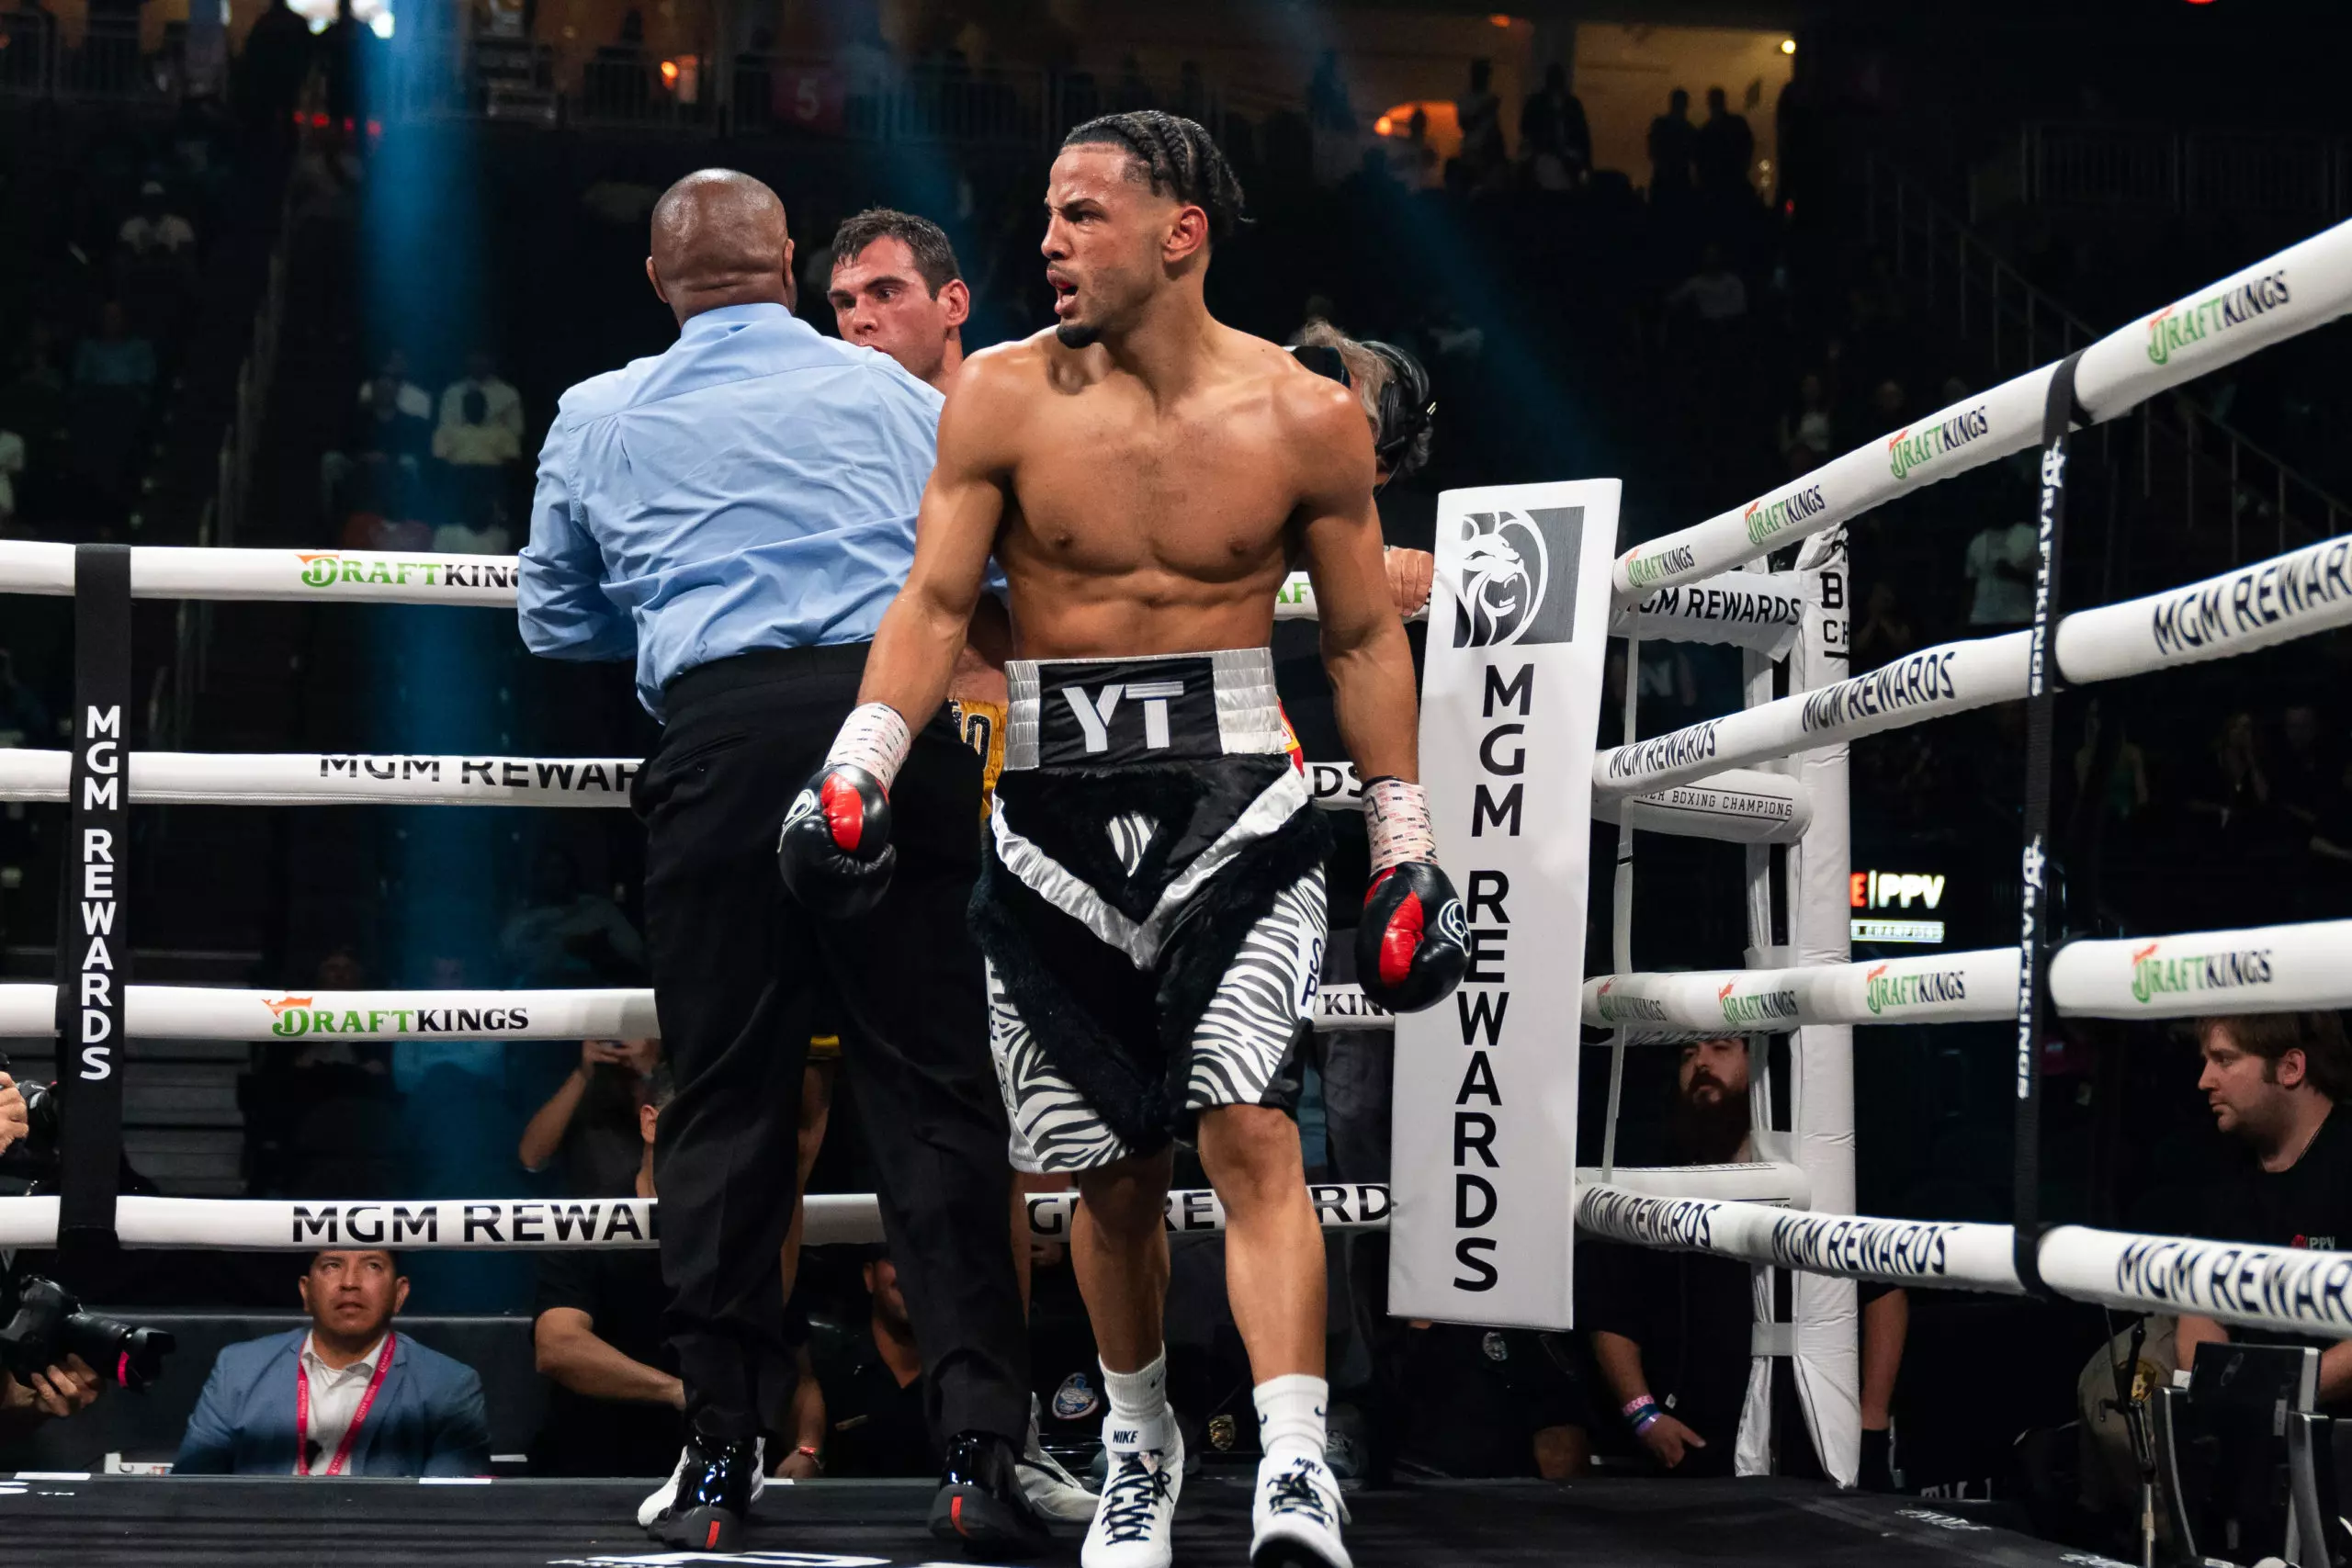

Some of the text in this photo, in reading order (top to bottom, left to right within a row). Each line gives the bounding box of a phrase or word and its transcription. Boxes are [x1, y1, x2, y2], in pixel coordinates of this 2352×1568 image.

[2148, 270, 2290, 366] DRAFTKINGS
[1890, 406, 1988, 480] DRAFTKINGS
[1747, 485, 1826, 545] DRAFTKINGS
[1627, 545, 1696, 589] DRAFTKINGS
[1684, 588, 1802, 626] REWARDS
[2152, 585, 2229, 656] MGM
[1062, 682, 1184, 751] YT
[1802, 651, 1955, 732] MGM REWARDS
[1609, 718, 1725, 779] MGM REWARDS
[1672, 791, 1715, 807] BOXING
[1722, 796, 1792, 817] CHAMPIONS
[80, 705, 120, 1079] MGM REWARDS
[1453, 663, 1534, 1292] MGM REWARDS
[1867, 971, 1966, 1014] DRAFTKINGS
[2132, 950, 2273, 1003] DRAFTKINGS
[272, 1008, 529, 1037] DRAFTKINGS
[1599, 994, 1668, 1022] DRAFTKINGS
[1723, 990, 1799, 1027] DRAFTKINGS
[292, 1203, 659, 1243] MGM REWA
[1580, 1187, 1722, 1248] MGM REWARDS
[1772, 1215, 1962, 1276] MGM REWARDS
[2117, 1239, 2205, 1305] MGM
[1113, 1430, 1138, 1444] NIKE
